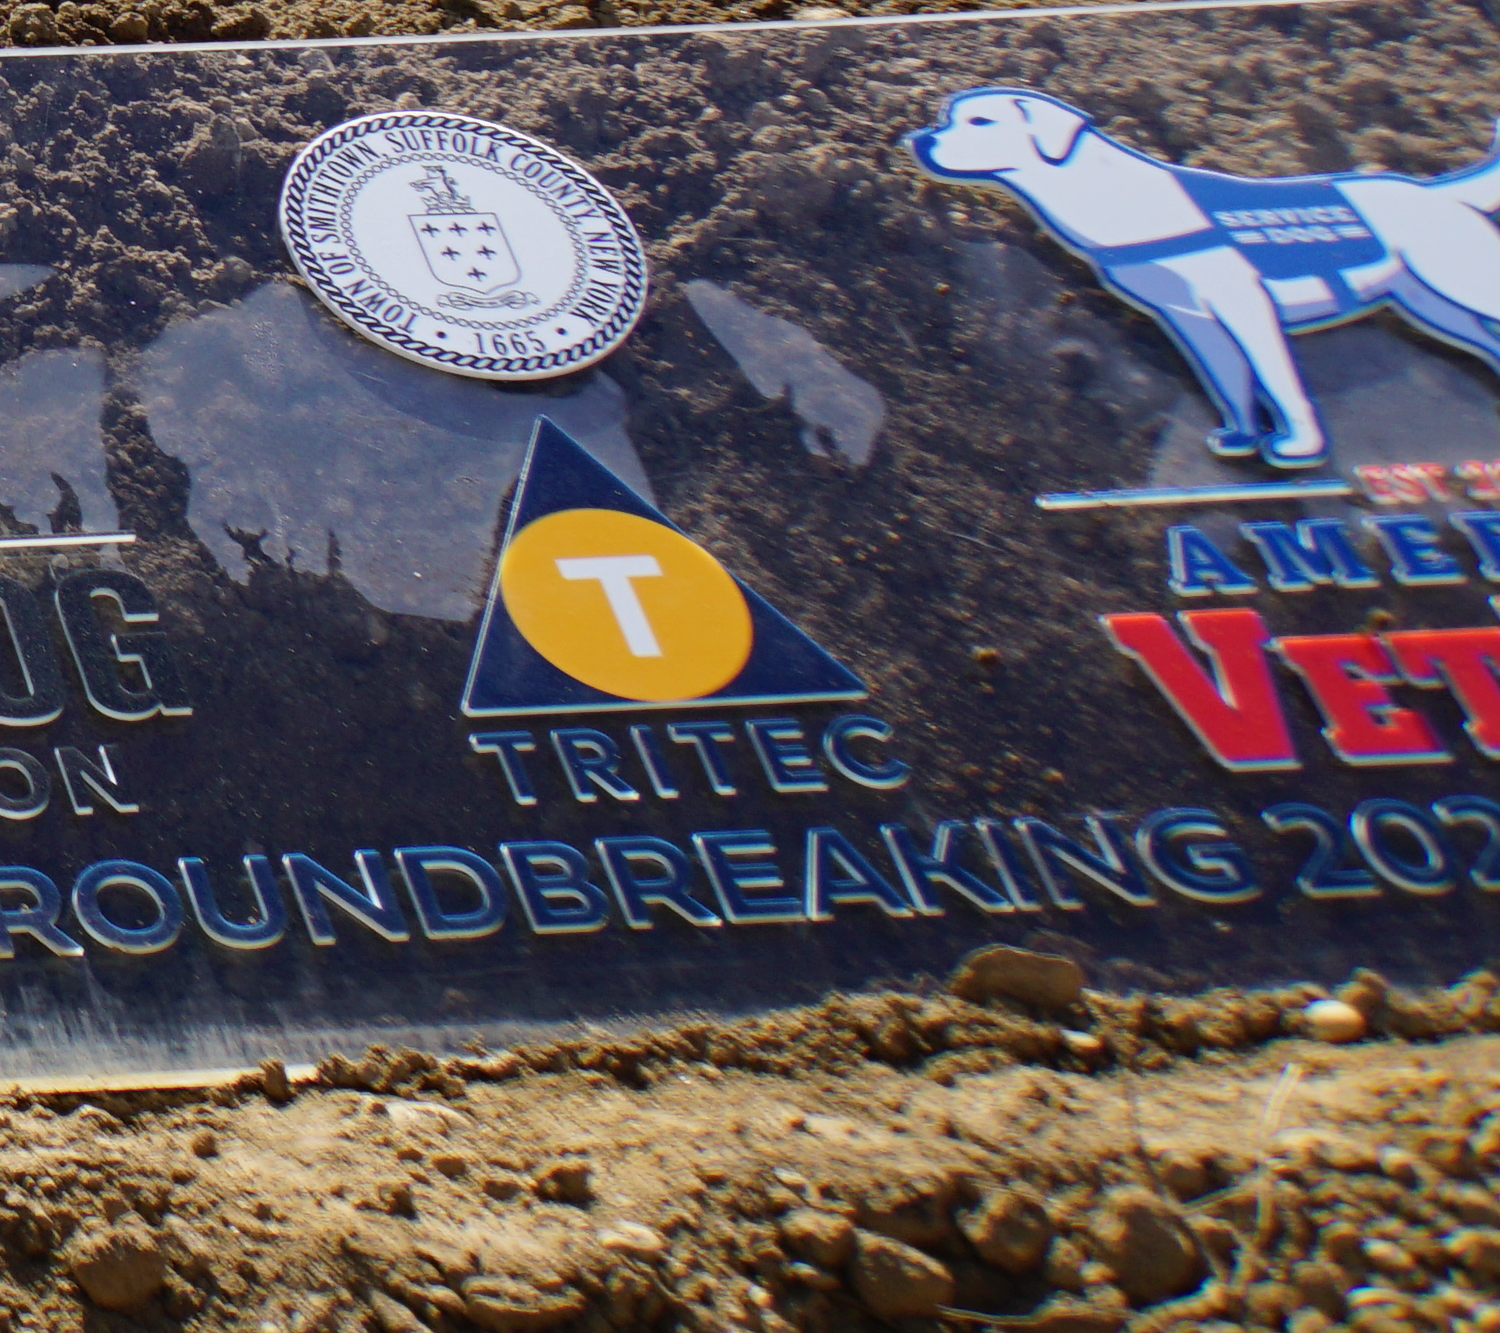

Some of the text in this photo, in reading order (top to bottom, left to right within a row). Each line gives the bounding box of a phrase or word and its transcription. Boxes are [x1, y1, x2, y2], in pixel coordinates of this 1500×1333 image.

[384, 129, 502, 162] SUFFOLK
[307, 140, 390, 244] SMITHTOWN,
[319, 251, 355, 275] OF
[585, 230, 621, 276] NEW
[346, 277, 422, 334] TOWN
[570, 278, 620, 328] YORK
[473, 330, 547, 356] 1665
[1352, 462, 1449, 504] EST
[554, 554, 663, 658] T
[469, 715, 912, 806] TRITEC
